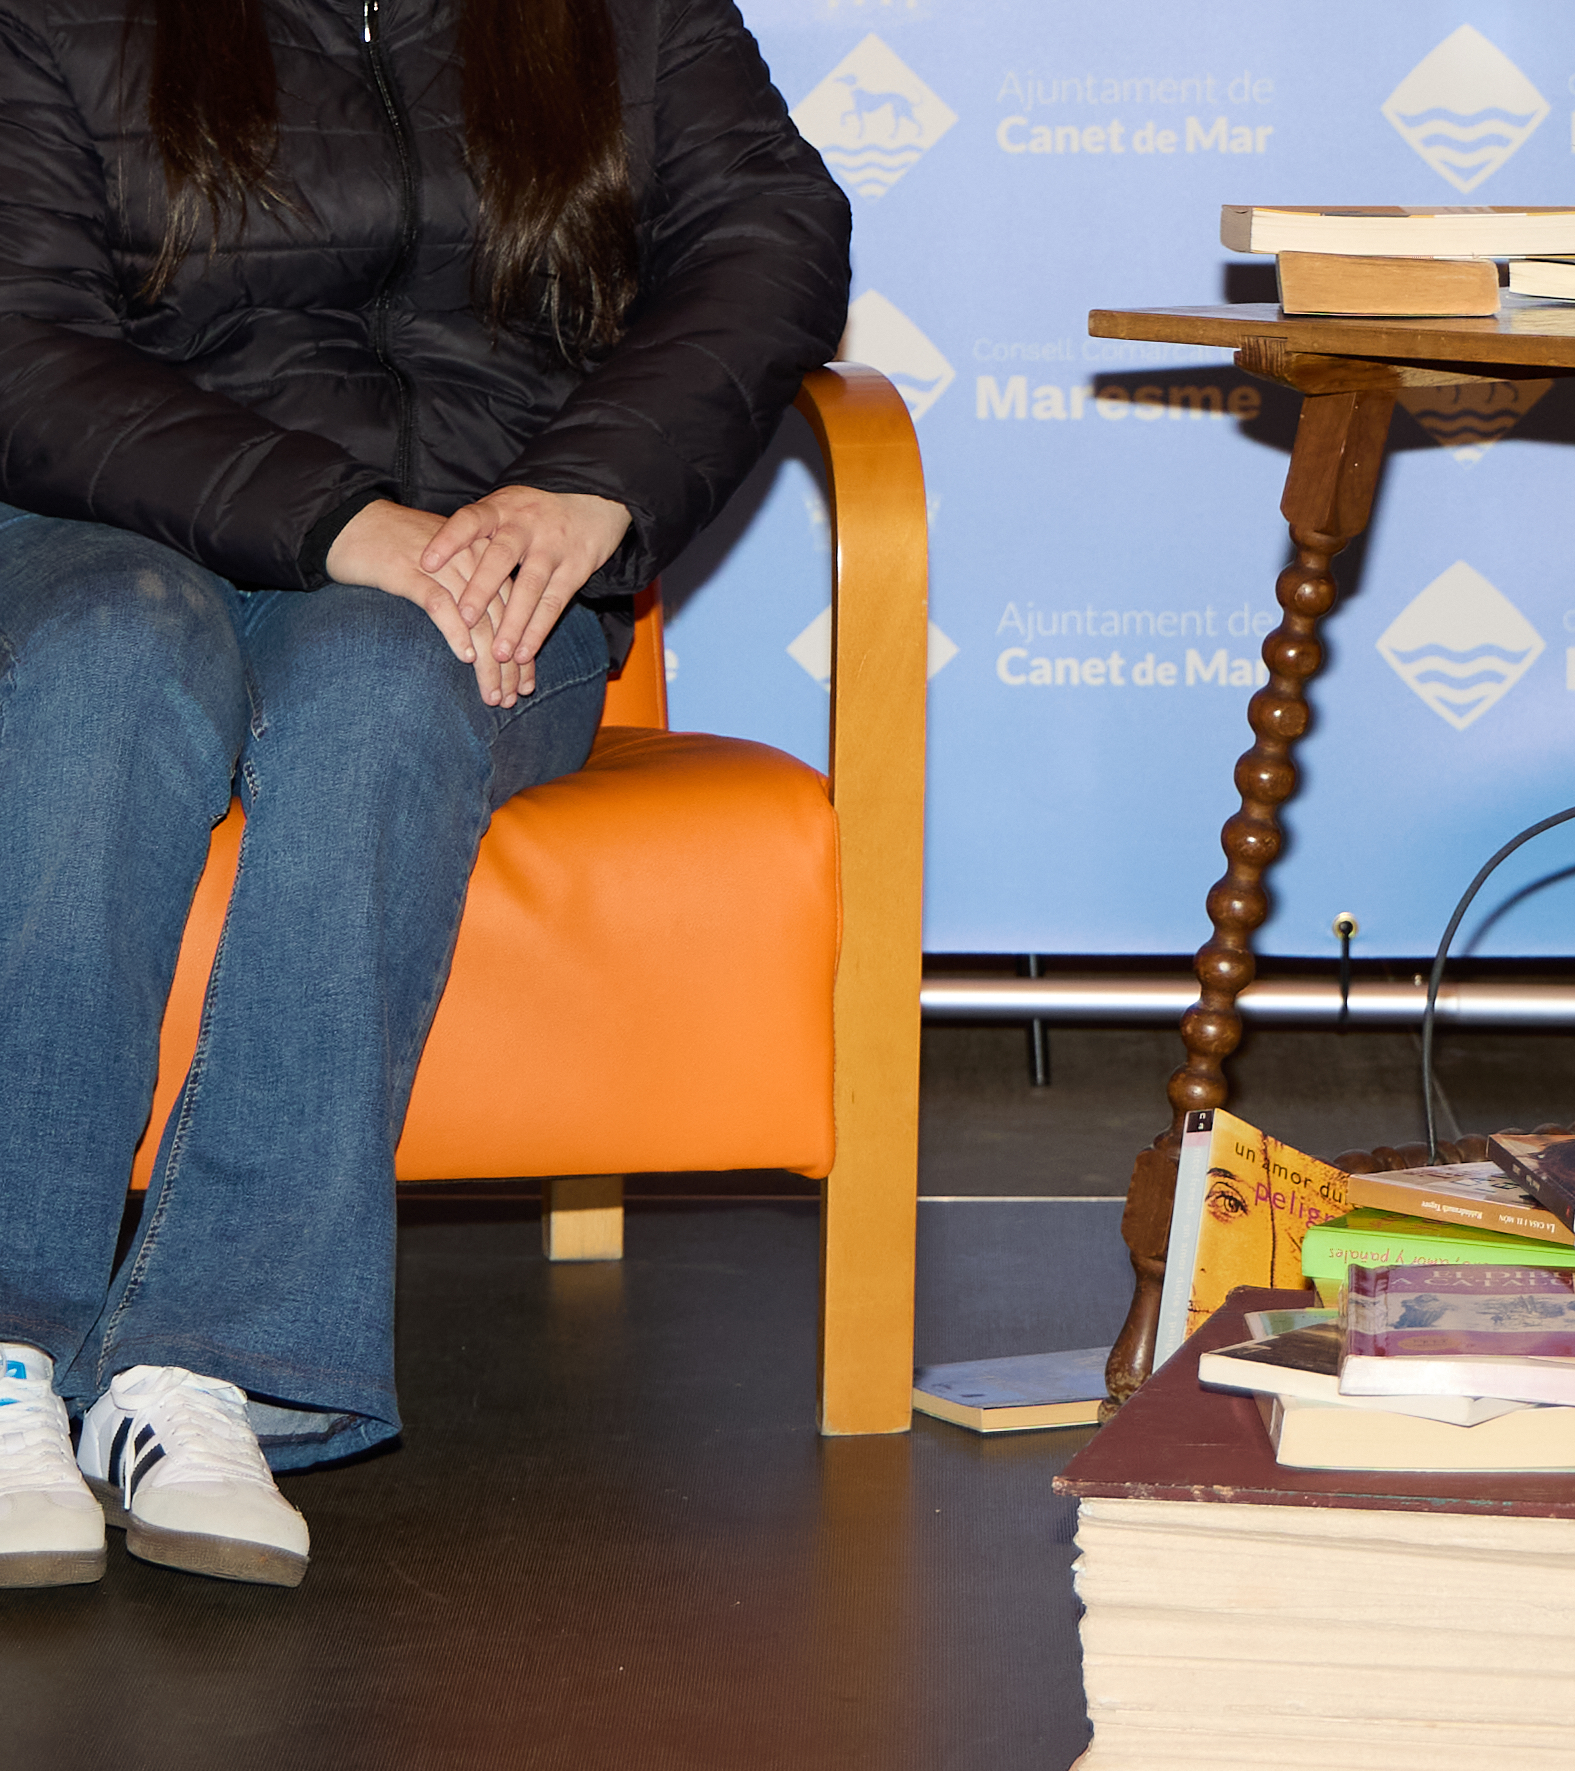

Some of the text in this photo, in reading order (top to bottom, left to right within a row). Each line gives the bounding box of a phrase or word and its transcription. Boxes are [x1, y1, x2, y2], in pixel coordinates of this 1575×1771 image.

[997, 602, 1274, 644] Ajuntament de
[996, 647, 1126, 686] Canet
[1132, 653, 1177, 686] de
[1235, 1141, 1256, 1163] un
[1261, 1157, 1313, 1189] amor
[1329, 1247, 1390, 1264] pañales
